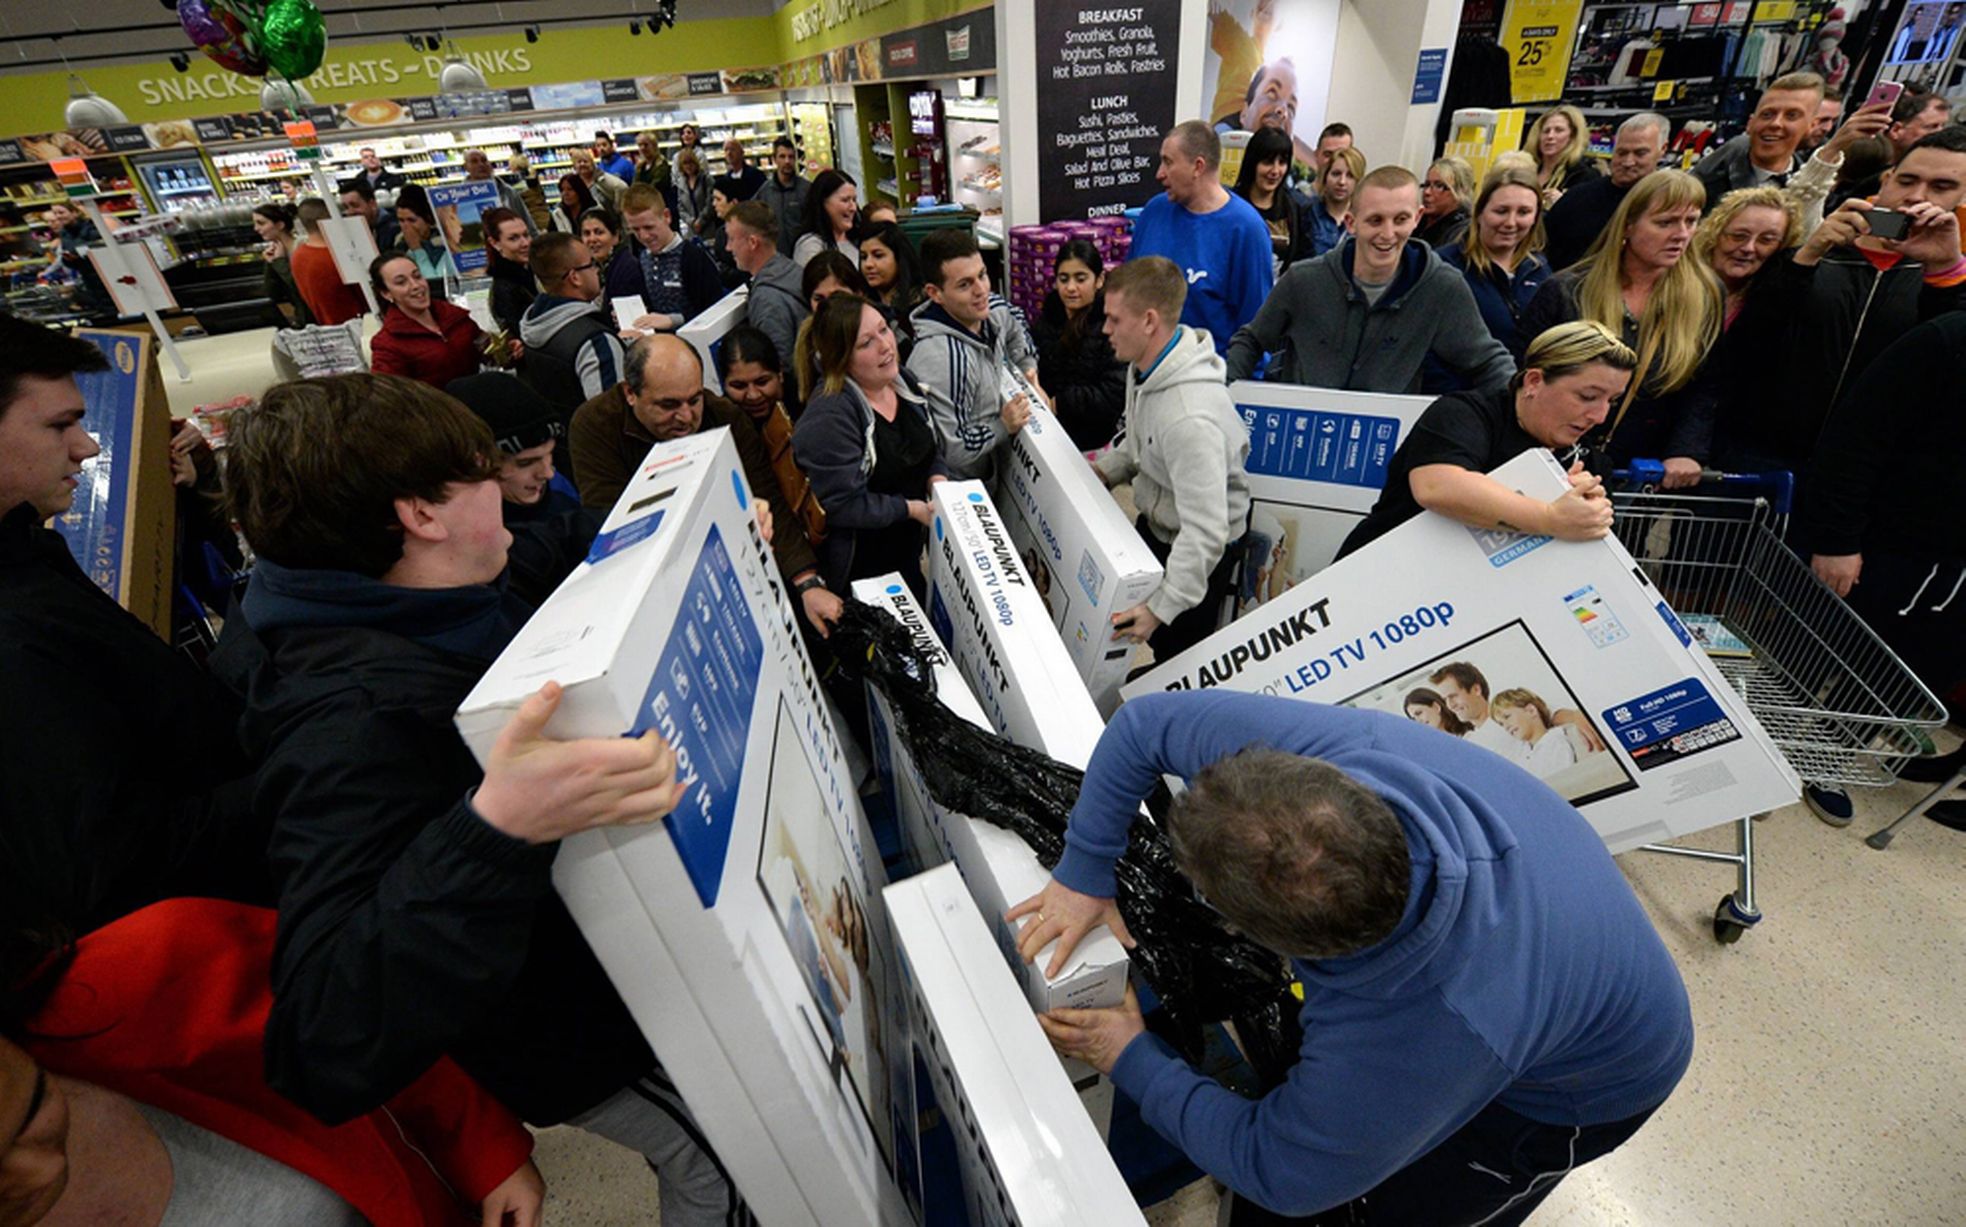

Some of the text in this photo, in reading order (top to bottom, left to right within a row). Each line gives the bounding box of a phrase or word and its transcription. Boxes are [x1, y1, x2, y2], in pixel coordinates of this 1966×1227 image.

[1078, 8, 1143, 24] BREAKFAST
[1065, 25, 1154, 43] Smoothies, Granola,
[1061, 42, 1158, 64] Yoghurts, Fresh Fruit,
[1052, 59, 1165, 78] Hot Bacon Rolls, Pastries
[138, 71, 261, 105] SNACKS
[310, 59, 400, 88] REATS
[1091, 95, 1128, 109] LUNCH
[1078, 112, 1138, 128] Sushi, Pasties,
[1056, 125, 1159, 148] Baguettes, Sandwiches,
[1086, 142, 1130, 157] Meal Deal,
[1064, 161, 1088, 175] Salad
[1091, 159, 1108, 172] And
[1110, 158, 1132, 170] Olive
[1074, 171, 1141, 189] Hot Pizza Slices
[1088, 203, 1126, 218] DINNER
[972, 504, 1025, 587] BLAUPUNKT
[973, 549, 992, 571] LED
[982, 570, 999, 587] TV
[942, 537, 1009, 693] BLAUPUNKT
[990, 588, 1014, 626] 1080p
[748, 519, 840, 763] BLAUPUNKT
[1285, 658, 1331, 693] LED
[1330, 639, 1365, 669] TV
[1369, 601, 1455, 650] 1080p
[652, 690, 698, 785] Enjoy
